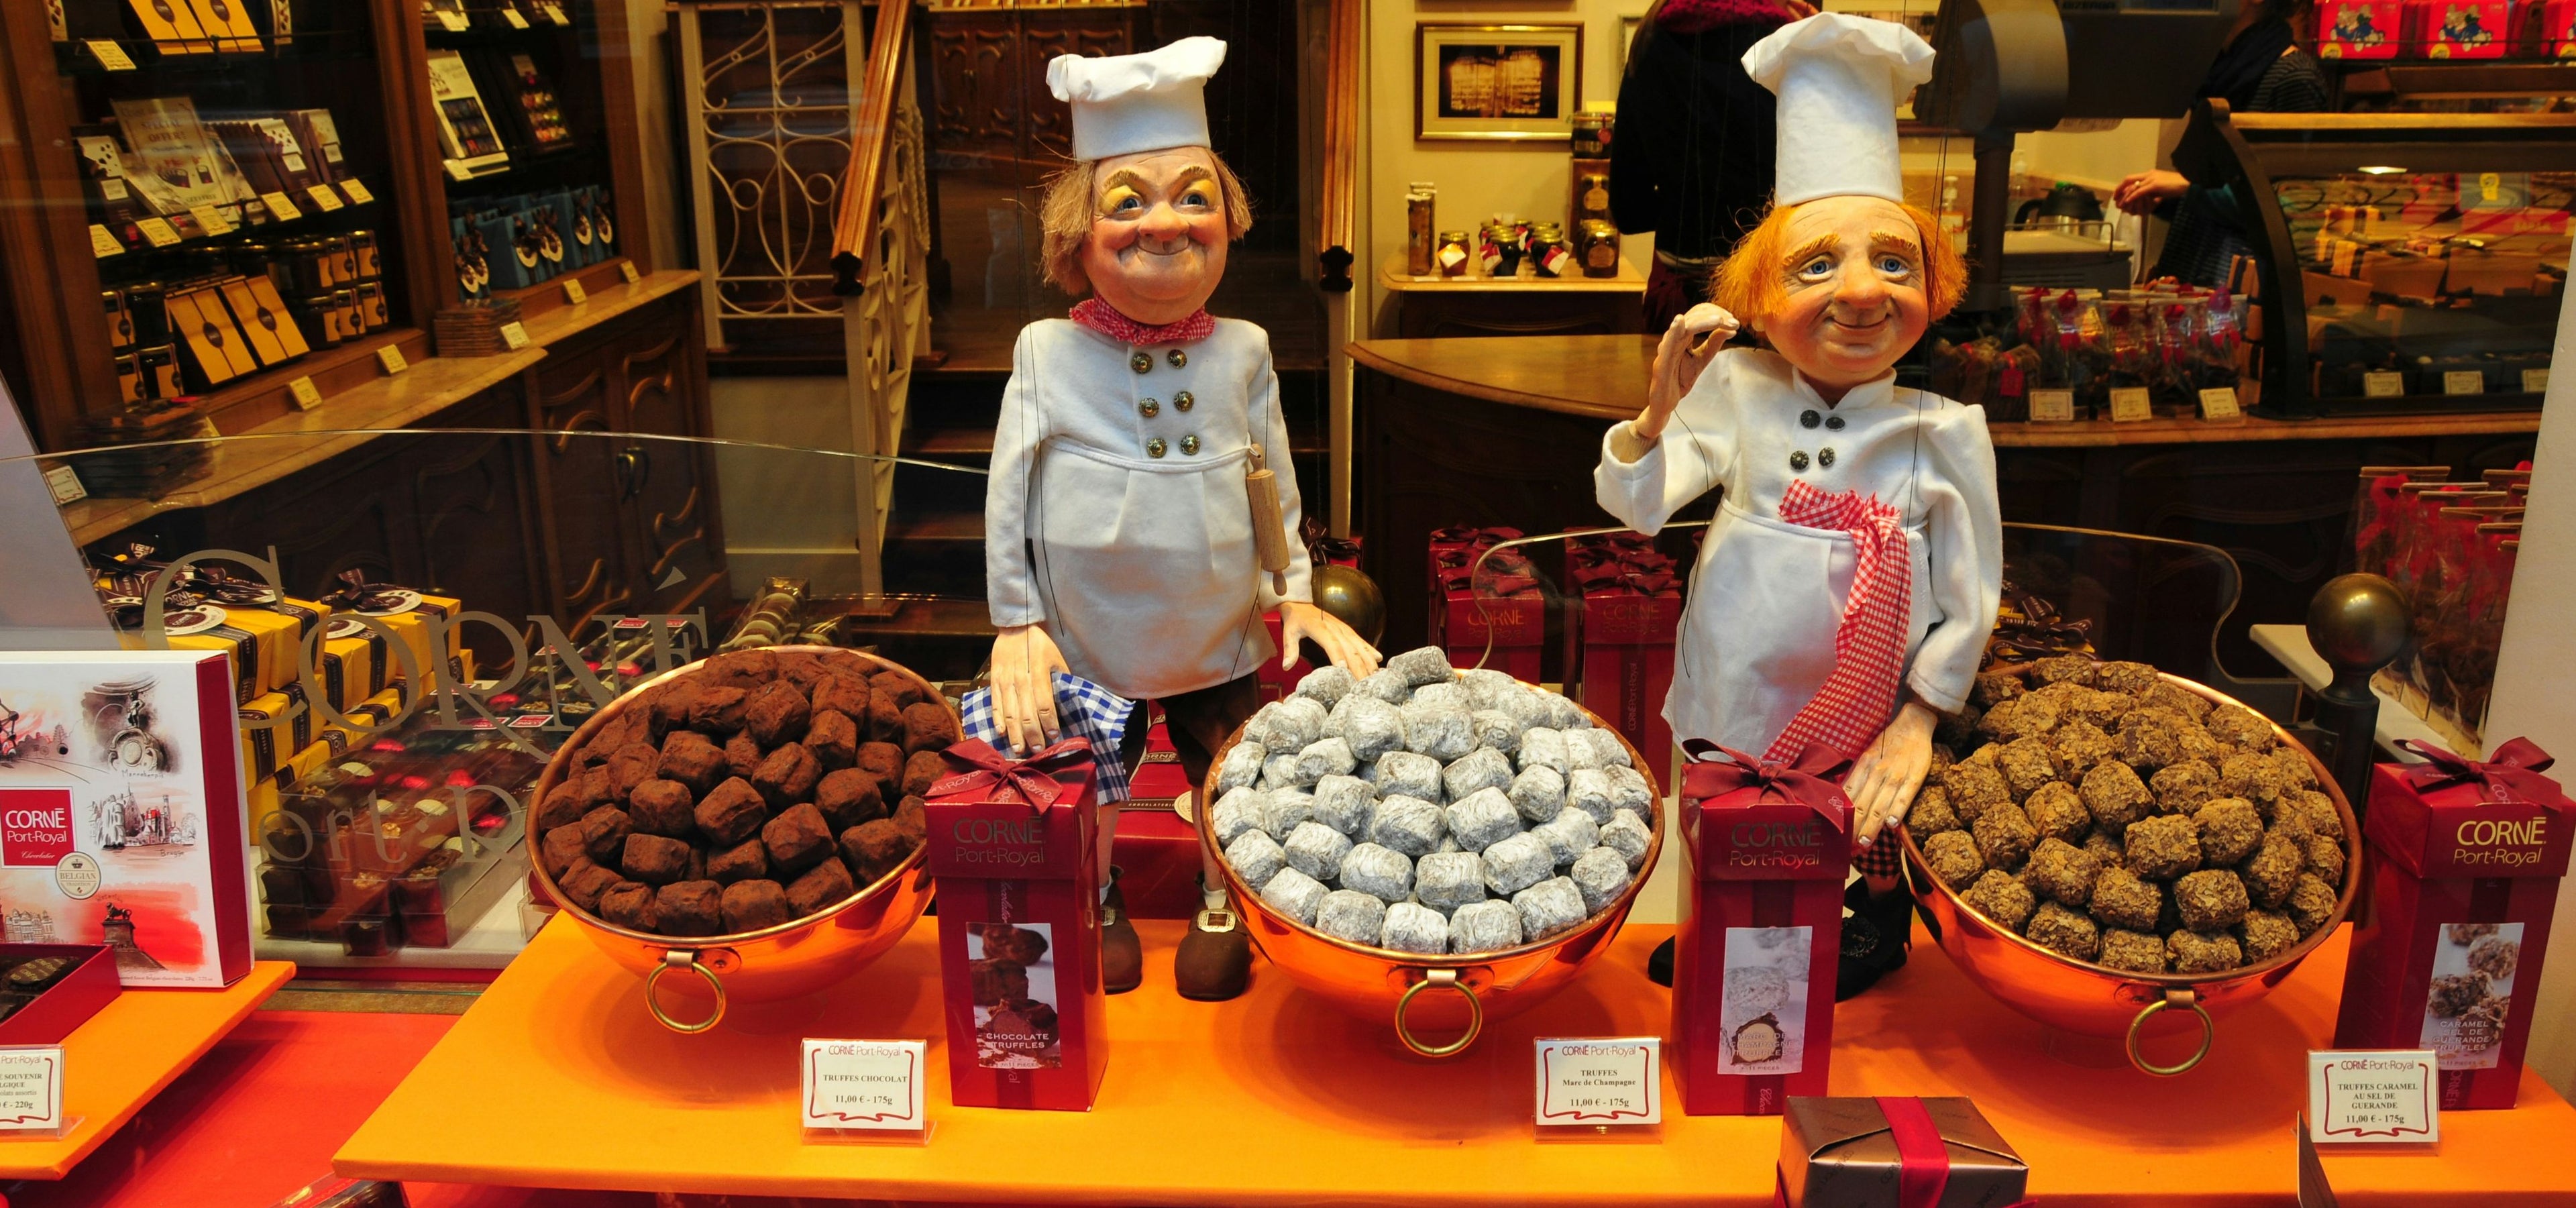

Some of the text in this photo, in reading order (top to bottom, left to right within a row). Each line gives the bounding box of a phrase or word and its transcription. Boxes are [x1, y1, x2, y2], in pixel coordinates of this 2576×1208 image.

[7, 830, 67, 845] Port-Royal
[955, 847, 1044, 867] Port-Royal
[1730, 850, 1820, 869] Port-Royal
[2453, 848, 2542, 867] Port-Royal
[60, 872, 97, 880] BELGIAN
[856, 1046, 900, 1058] Port-Royal
[1591, 1045, 1636, 1058] Port-Royal
[2369, 1060, 2414, 1072] Port-Royal
[835, 1095, 857, 1104] 11,00
[859, 1095, 865, 1103] €
[873, 1095, 893, 1105] 175g
[1570, 1098, 1593, 1107] 11,00
[1609, 1098, 1629, 1107] 175g
[2346, 1115, 2369, 1123] 11,00
[2371, 1115, 2376, 1123] €
[2385, 1115, 2405, 1124] 175g
